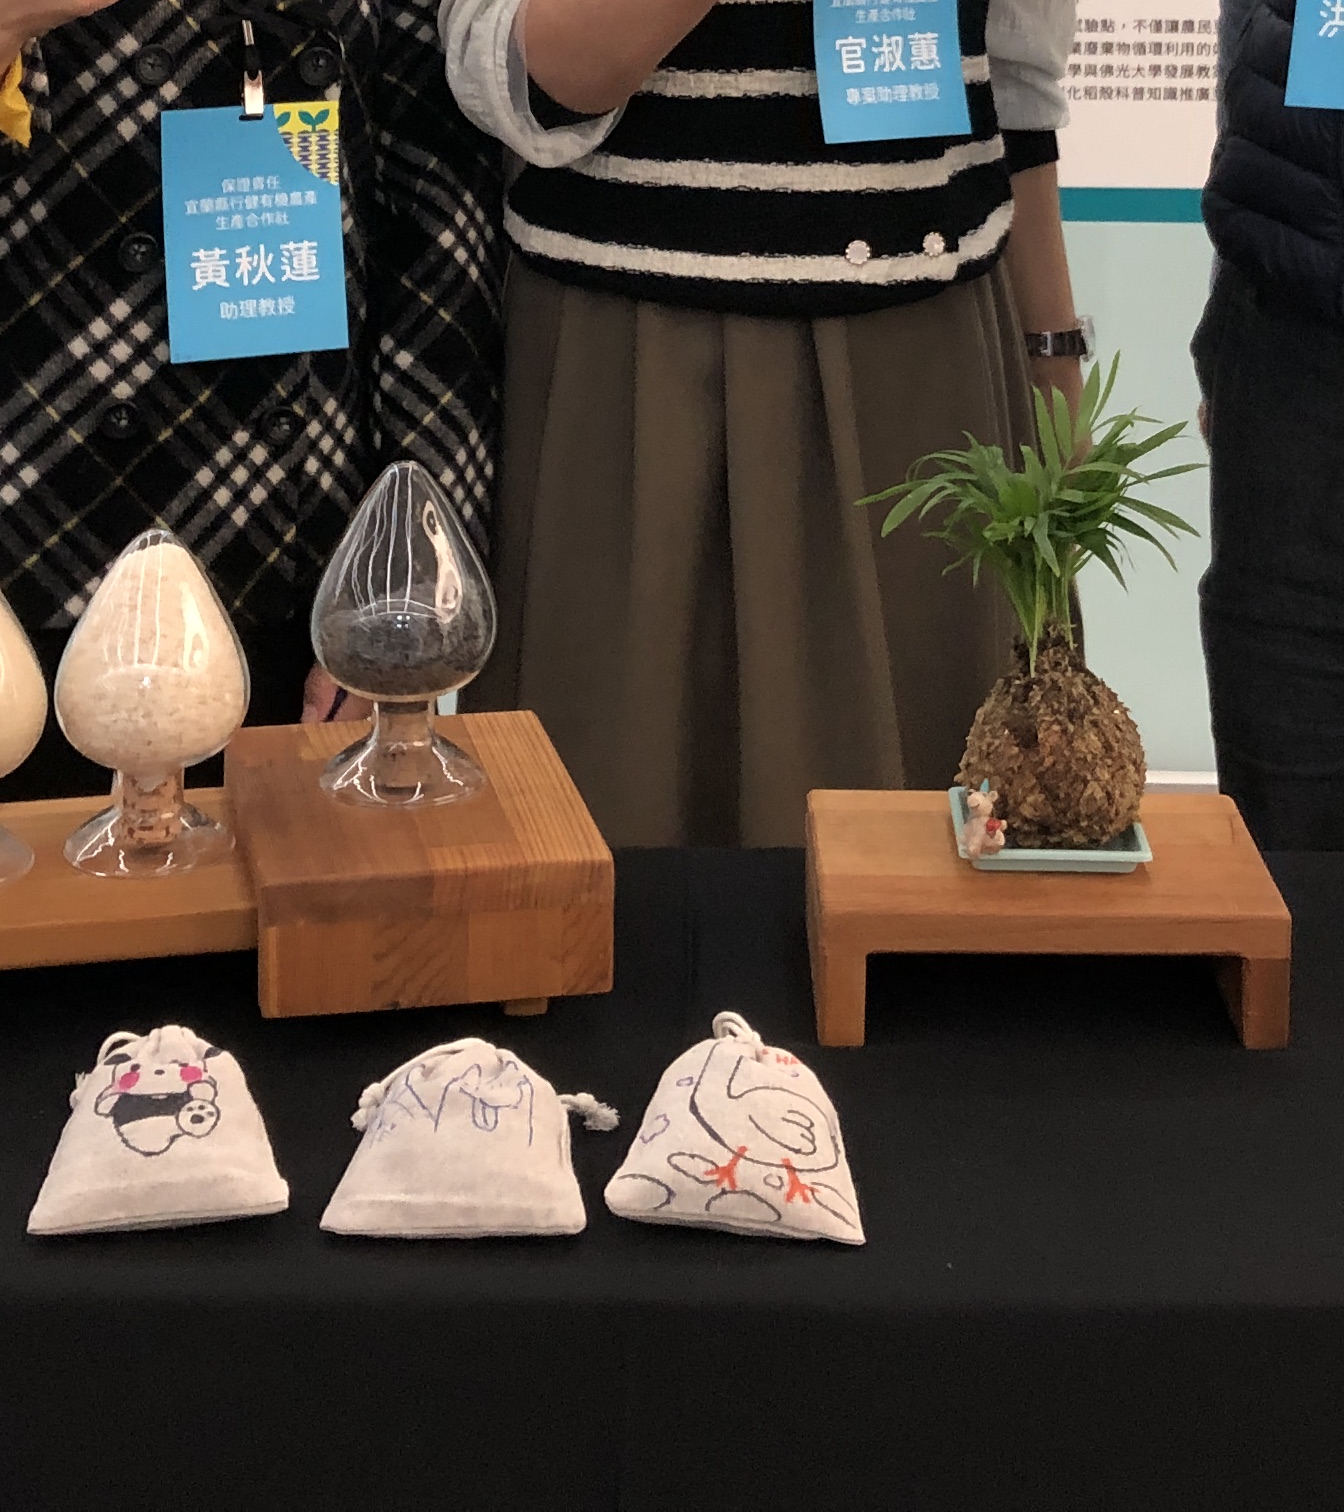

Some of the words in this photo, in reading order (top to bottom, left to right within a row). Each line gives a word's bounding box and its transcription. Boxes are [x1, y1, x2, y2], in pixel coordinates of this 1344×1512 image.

[222, 175, 281, 193] 保證責任
[216, 212, 289, 230] 生產合作社
[191, 241, 320, 290] 黃秋蓮
[220, 296, 295, 320] 助理教授
